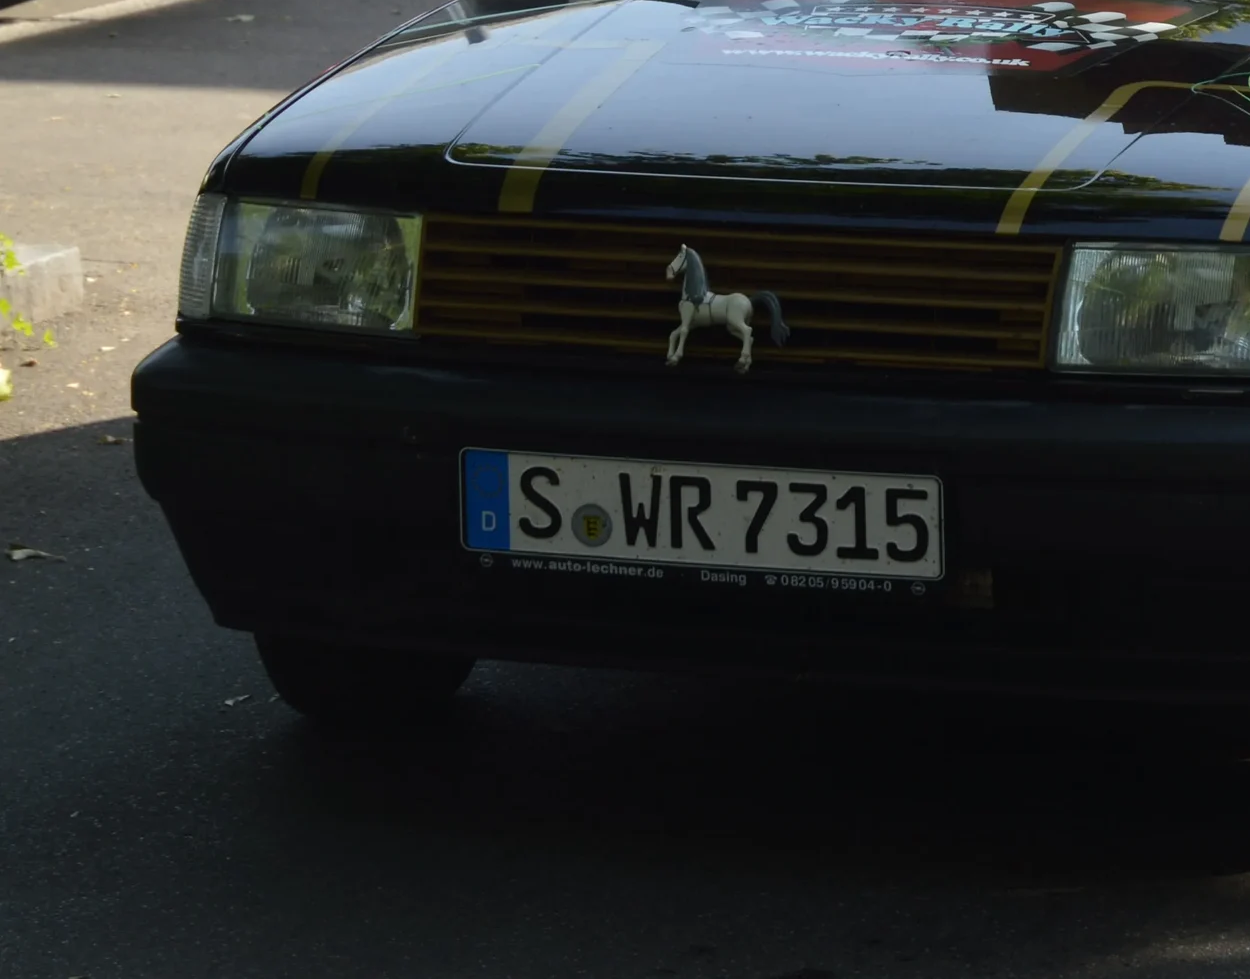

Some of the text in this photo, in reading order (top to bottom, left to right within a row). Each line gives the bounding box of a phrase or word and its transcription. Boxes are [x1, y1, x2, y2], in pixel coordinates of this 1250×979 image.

[760, 11, 1077, 38] Wacky Rally
[482, 511, 496, 531] D
[518, 465, 930, 563] S WR 7315
[511, 557, 665, 579] www.auto-lechner.de
[700, 569, 747, 587] Dasing
